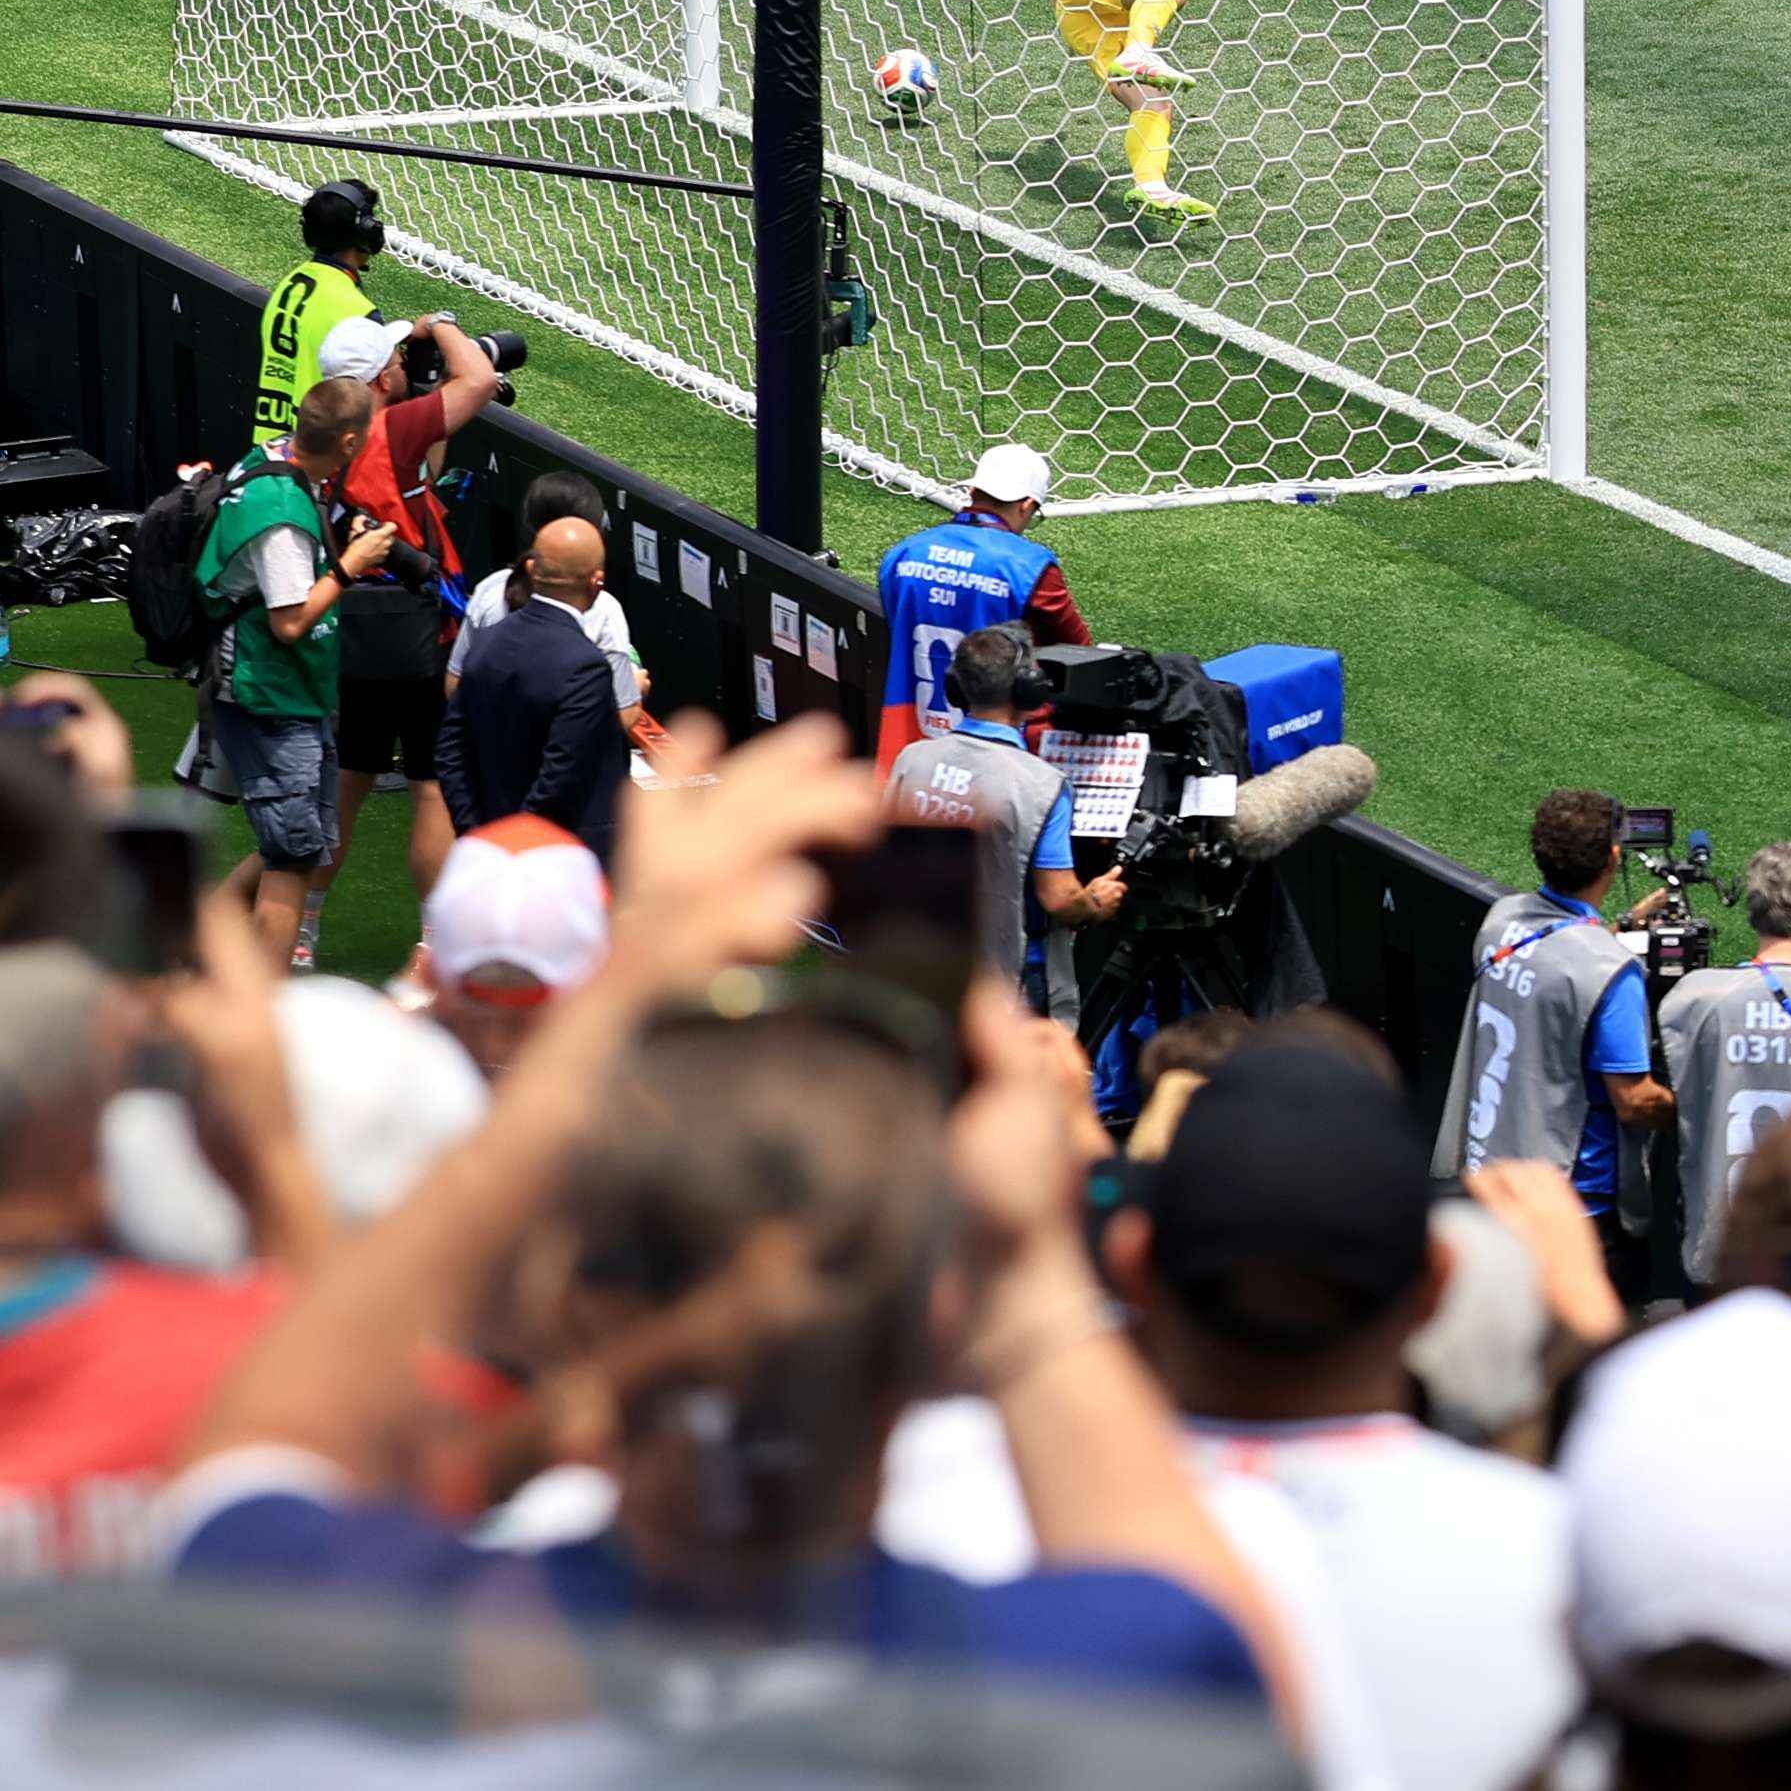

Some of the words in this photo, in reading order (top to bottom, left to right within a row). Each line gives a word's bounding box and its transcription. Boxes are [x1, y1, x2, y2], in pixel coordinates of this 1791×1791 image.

[897, 544, 975, 568] TEAM
[928, 587, 957, 607] SUI
[931, 762, 973, 796] HB
